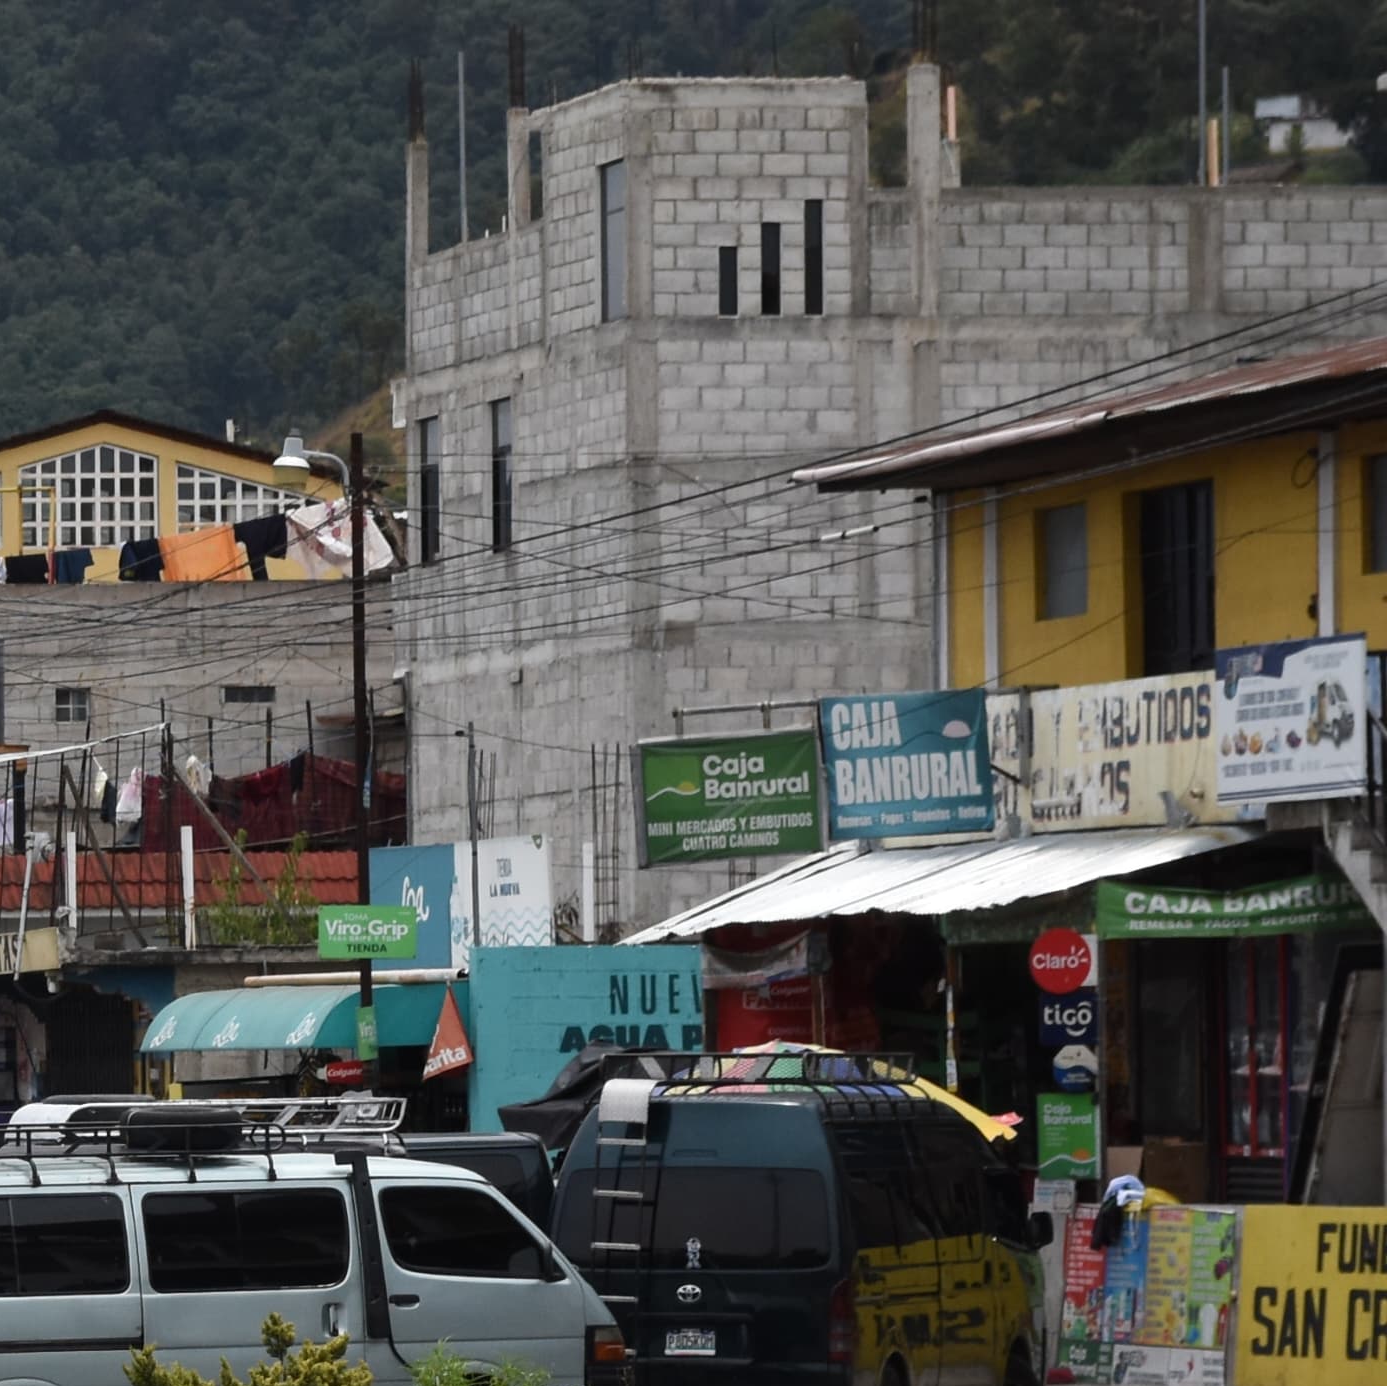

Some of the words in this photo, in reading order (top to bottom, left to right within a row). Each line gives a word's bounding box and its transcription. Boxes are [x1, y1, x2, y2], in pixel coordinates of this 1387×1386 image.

[831, 701, 901, 751] CAJA
[703, 752, 765, 779] Caja
[835, 750, 982, 806] BANRURAL
[704, 771, 810, 800] Banrural
[648, 822, 673, 837] MINI
[676, 818, 737, 836] MERCADOS
[739, 817, 747, 830] Y
[749, 812, 813, 829] EMBUTIDOS
[682, 834, 726, 851] CUATRO
[728, 831, 780, 848] CAMINOS
[1124, 891, 1212, 915] CAJA
[346, 943, 388, 953] TIENDA
[1032, 953, 1080, 969] Claro
[1043, 1002, 1093, 1037] tigo
[559, 1023, 667, 1053] AGUA
[327, 1066, 364, 1079] Colgate
[1043, 1102, 1072, 1115] Caja
[1043, 1114, 1093, 1125] Banrural
[1250, 1286, 1327, 1360] SAN
